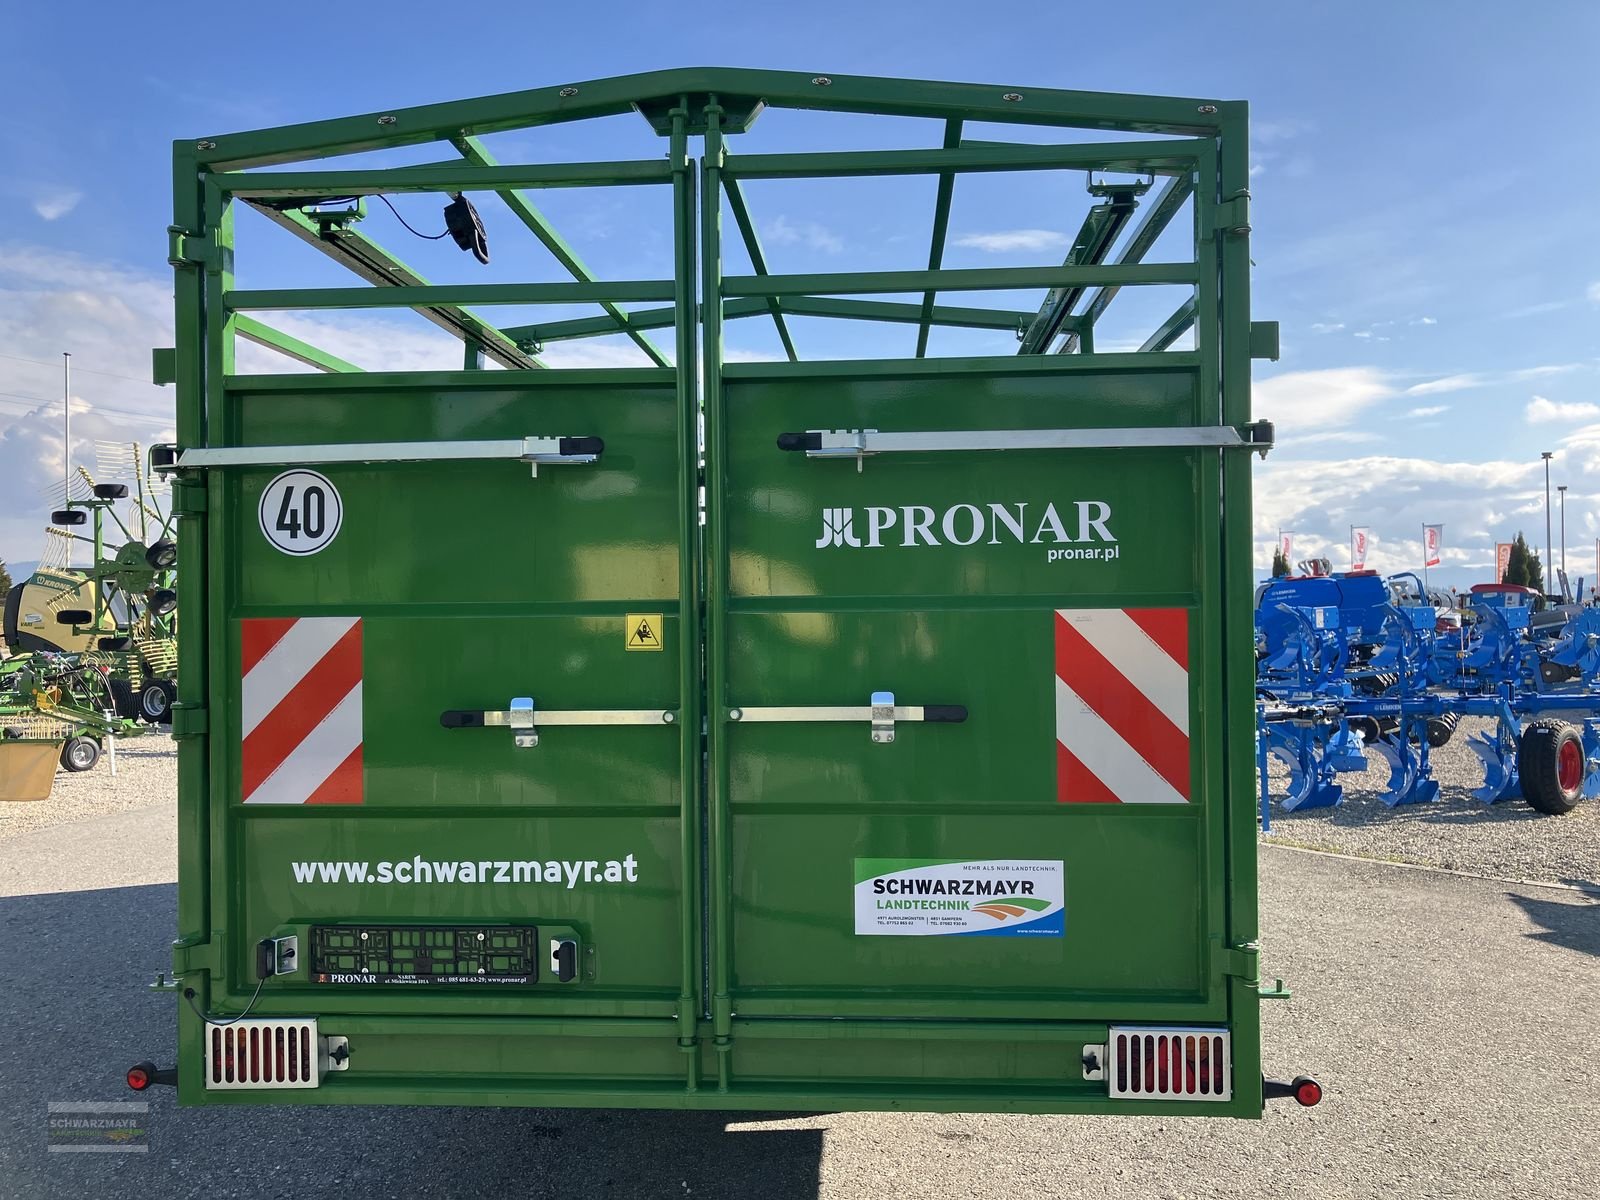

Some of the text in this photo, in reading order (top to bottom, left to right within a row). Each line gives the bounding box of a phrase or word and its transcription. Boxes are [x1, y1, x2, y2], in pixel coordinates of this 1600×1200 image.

[276, 486, 325, 538] 40
[864, 500, 1118, 548] PRONAR
[1047, 545, 1119, 563] pronar.pl
[292, 853, 638, 889] www.schwarzmayr.at
[873, 878, 1034, 896] SCHWARZMAYR
[876, 899, 970, 911] LANDTECHNIK
[331, 974, 377, 983] PRONAR
